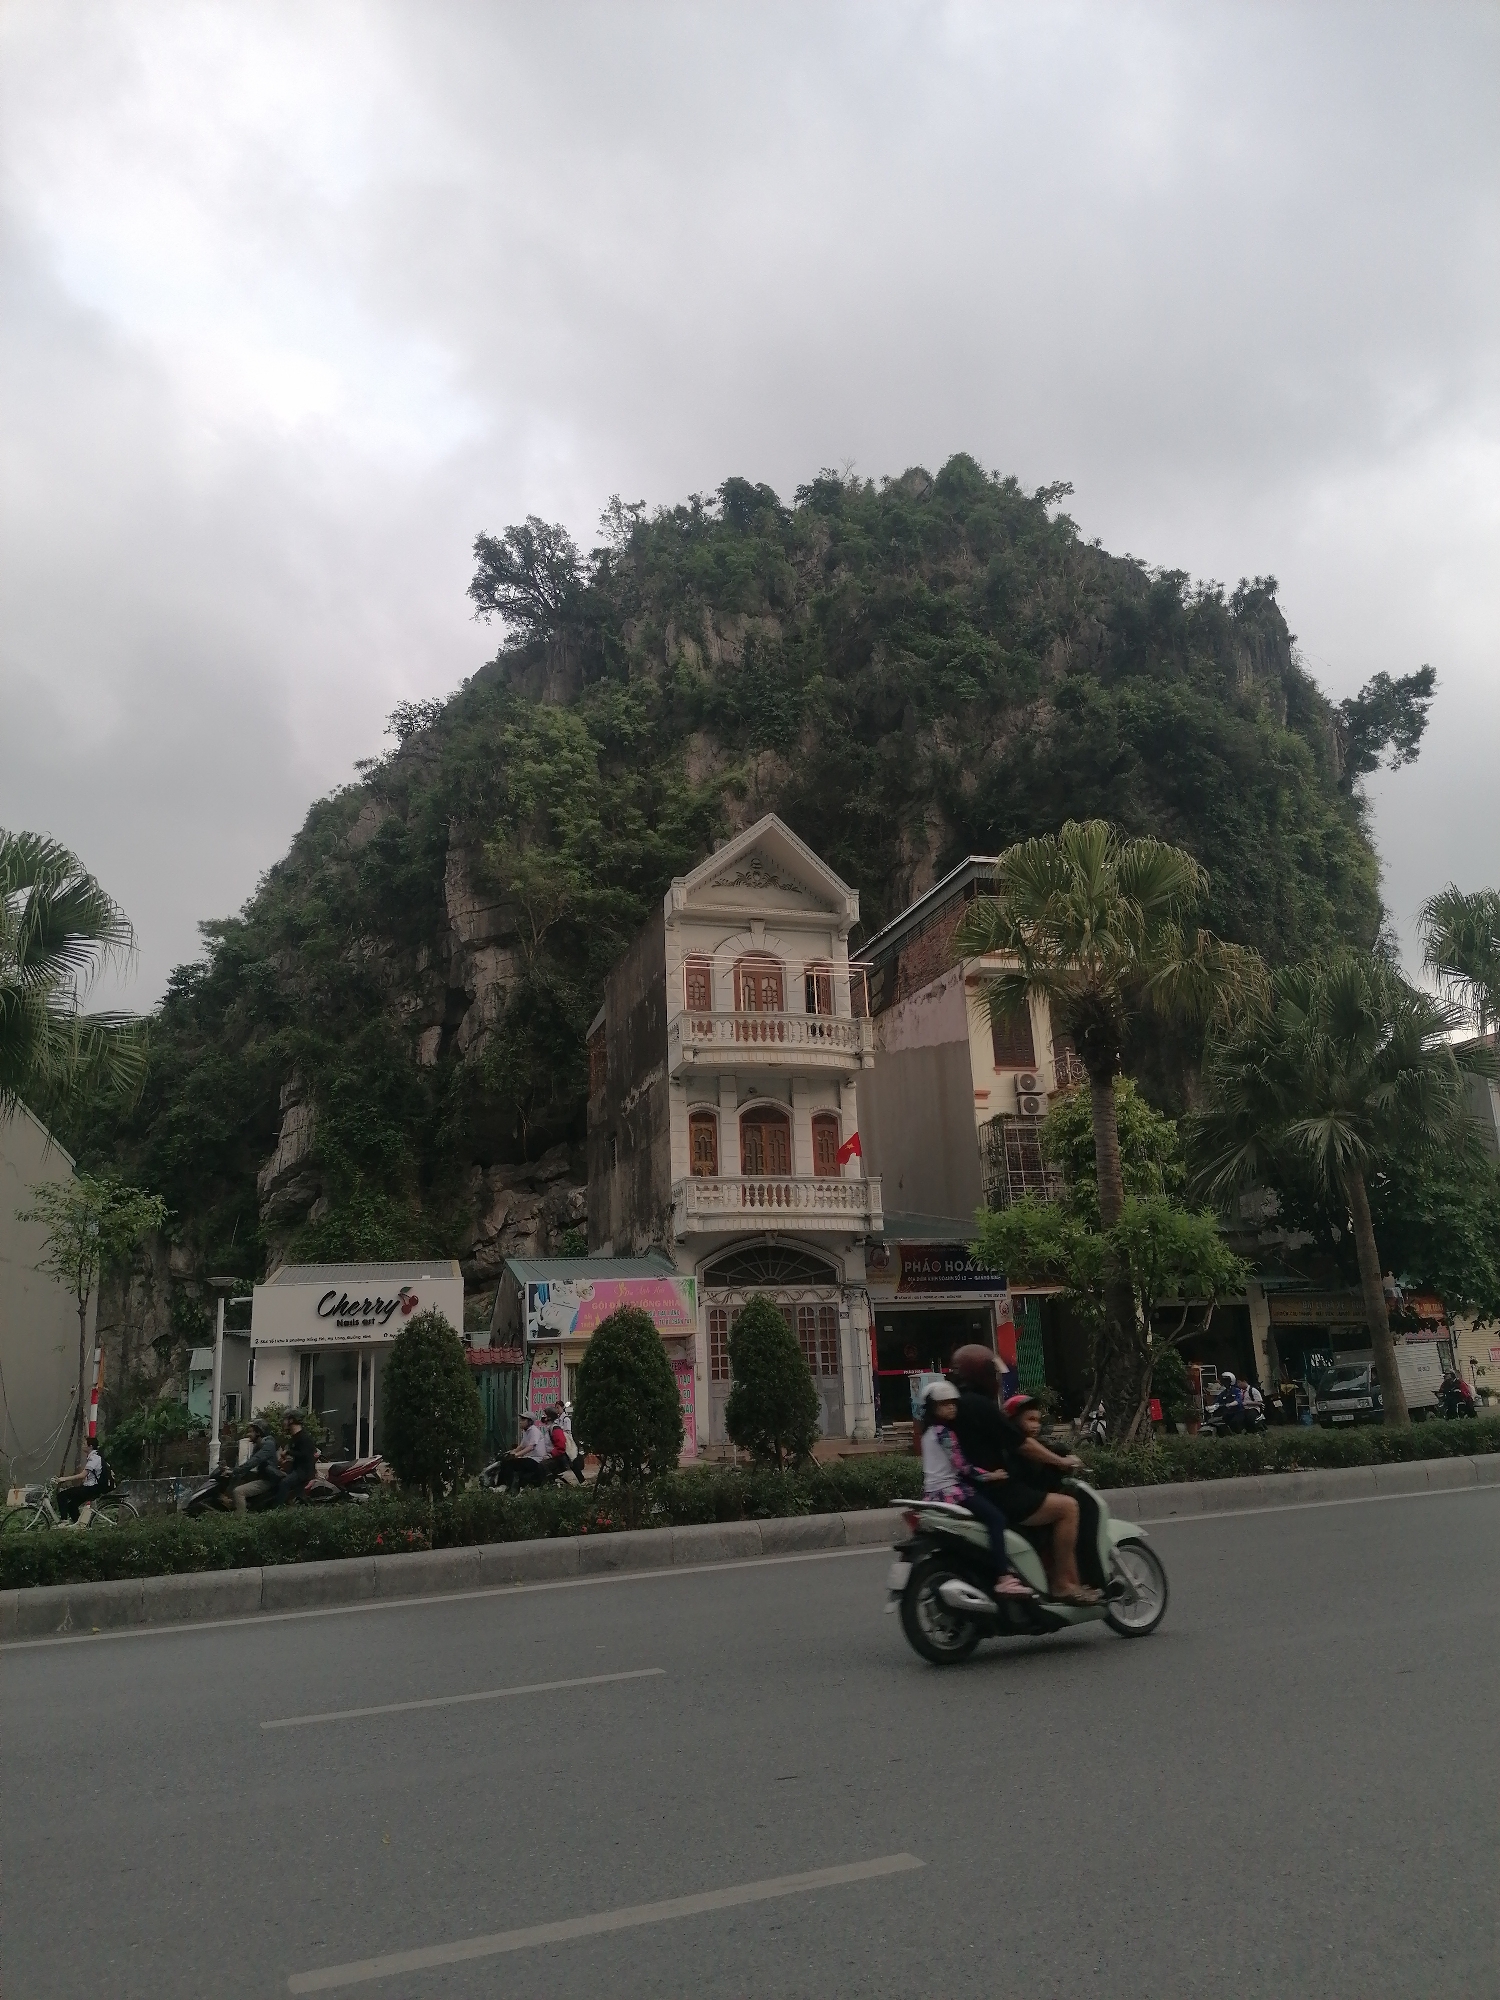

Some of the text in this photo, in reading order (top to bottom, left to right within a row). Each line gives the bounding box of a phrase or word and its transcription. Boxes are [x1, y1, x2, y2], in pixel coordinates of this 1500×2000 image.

[904, 1258, 942, 1273] PHÁO
[944, 1260, 974, 1272] HOA
[317, 1289, 400, 1325] Cherry
[591, 1301, 608, 1310] GỘI
[336, 1317, 376, 1327] Nails art
